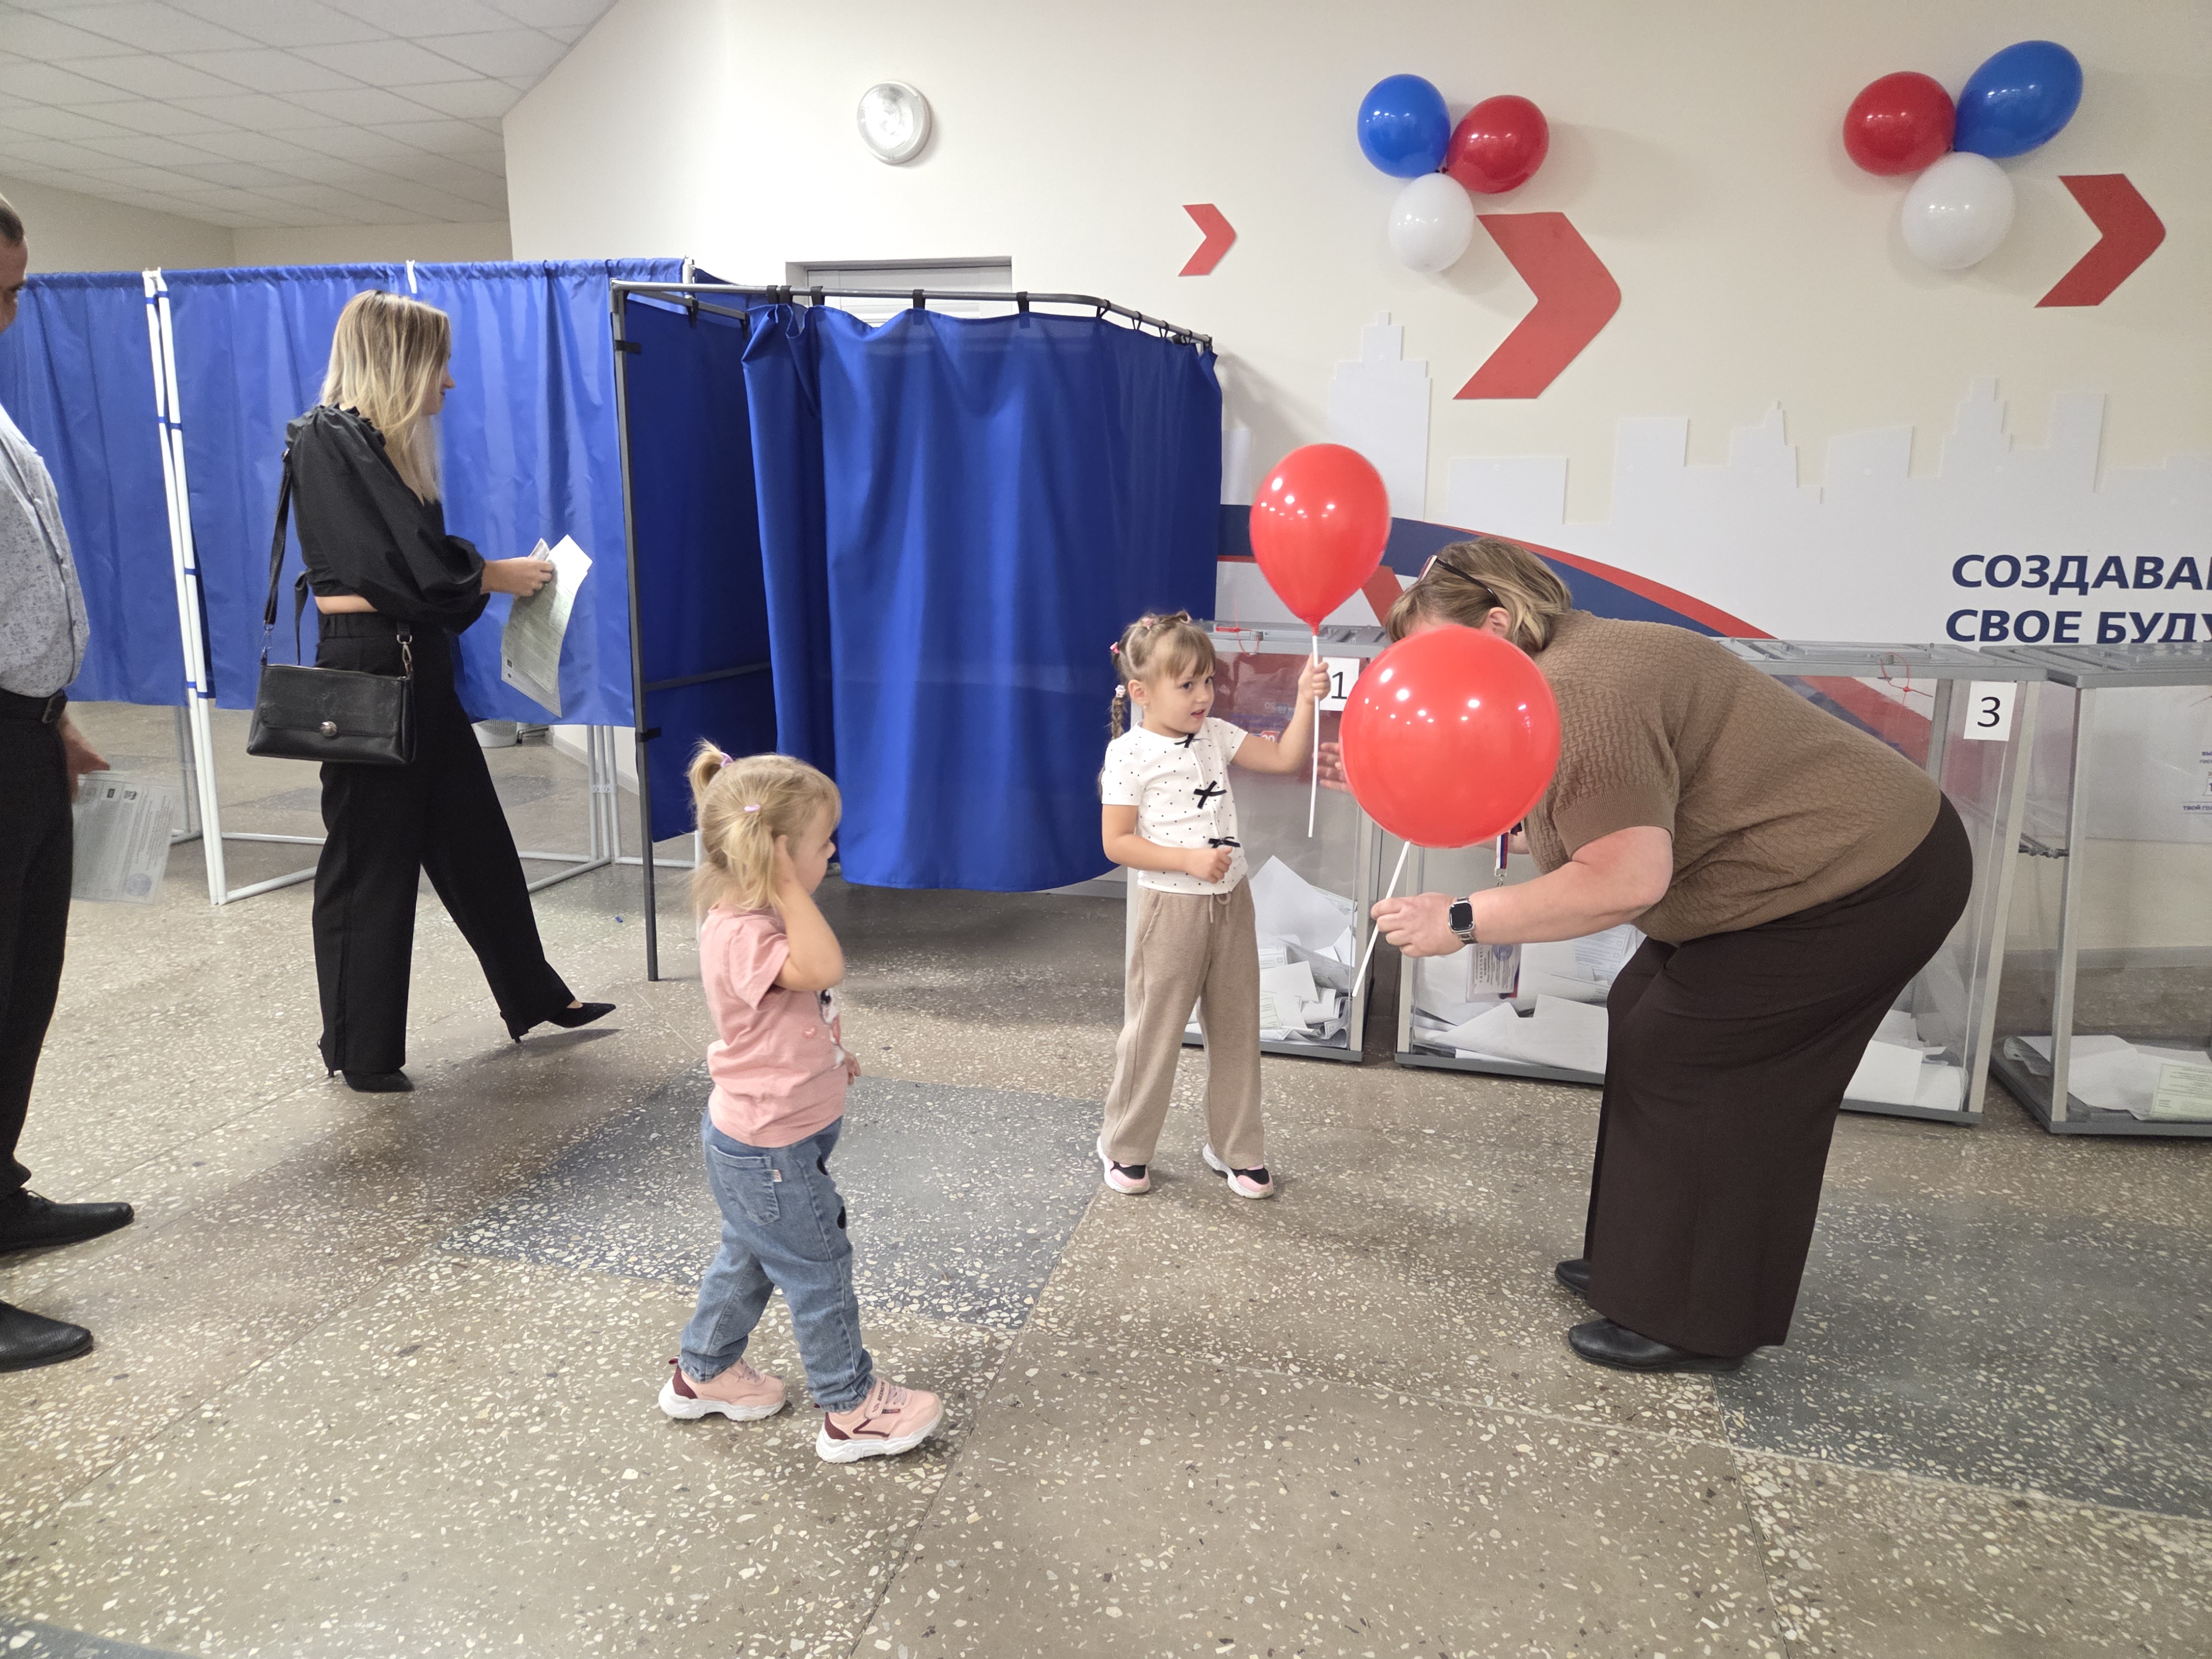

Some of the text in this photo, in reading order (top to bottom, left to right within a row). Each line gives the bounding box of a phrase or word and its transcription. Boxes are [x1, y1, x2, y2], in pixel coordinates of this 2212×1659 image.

[1952, 555, 2212, 595] СОЗДАВА
[1946, 609, 2082, 643] СВОЕ
[1331, 671, 1348, 700] 1
[1977, 697, 2001, 727] 3
